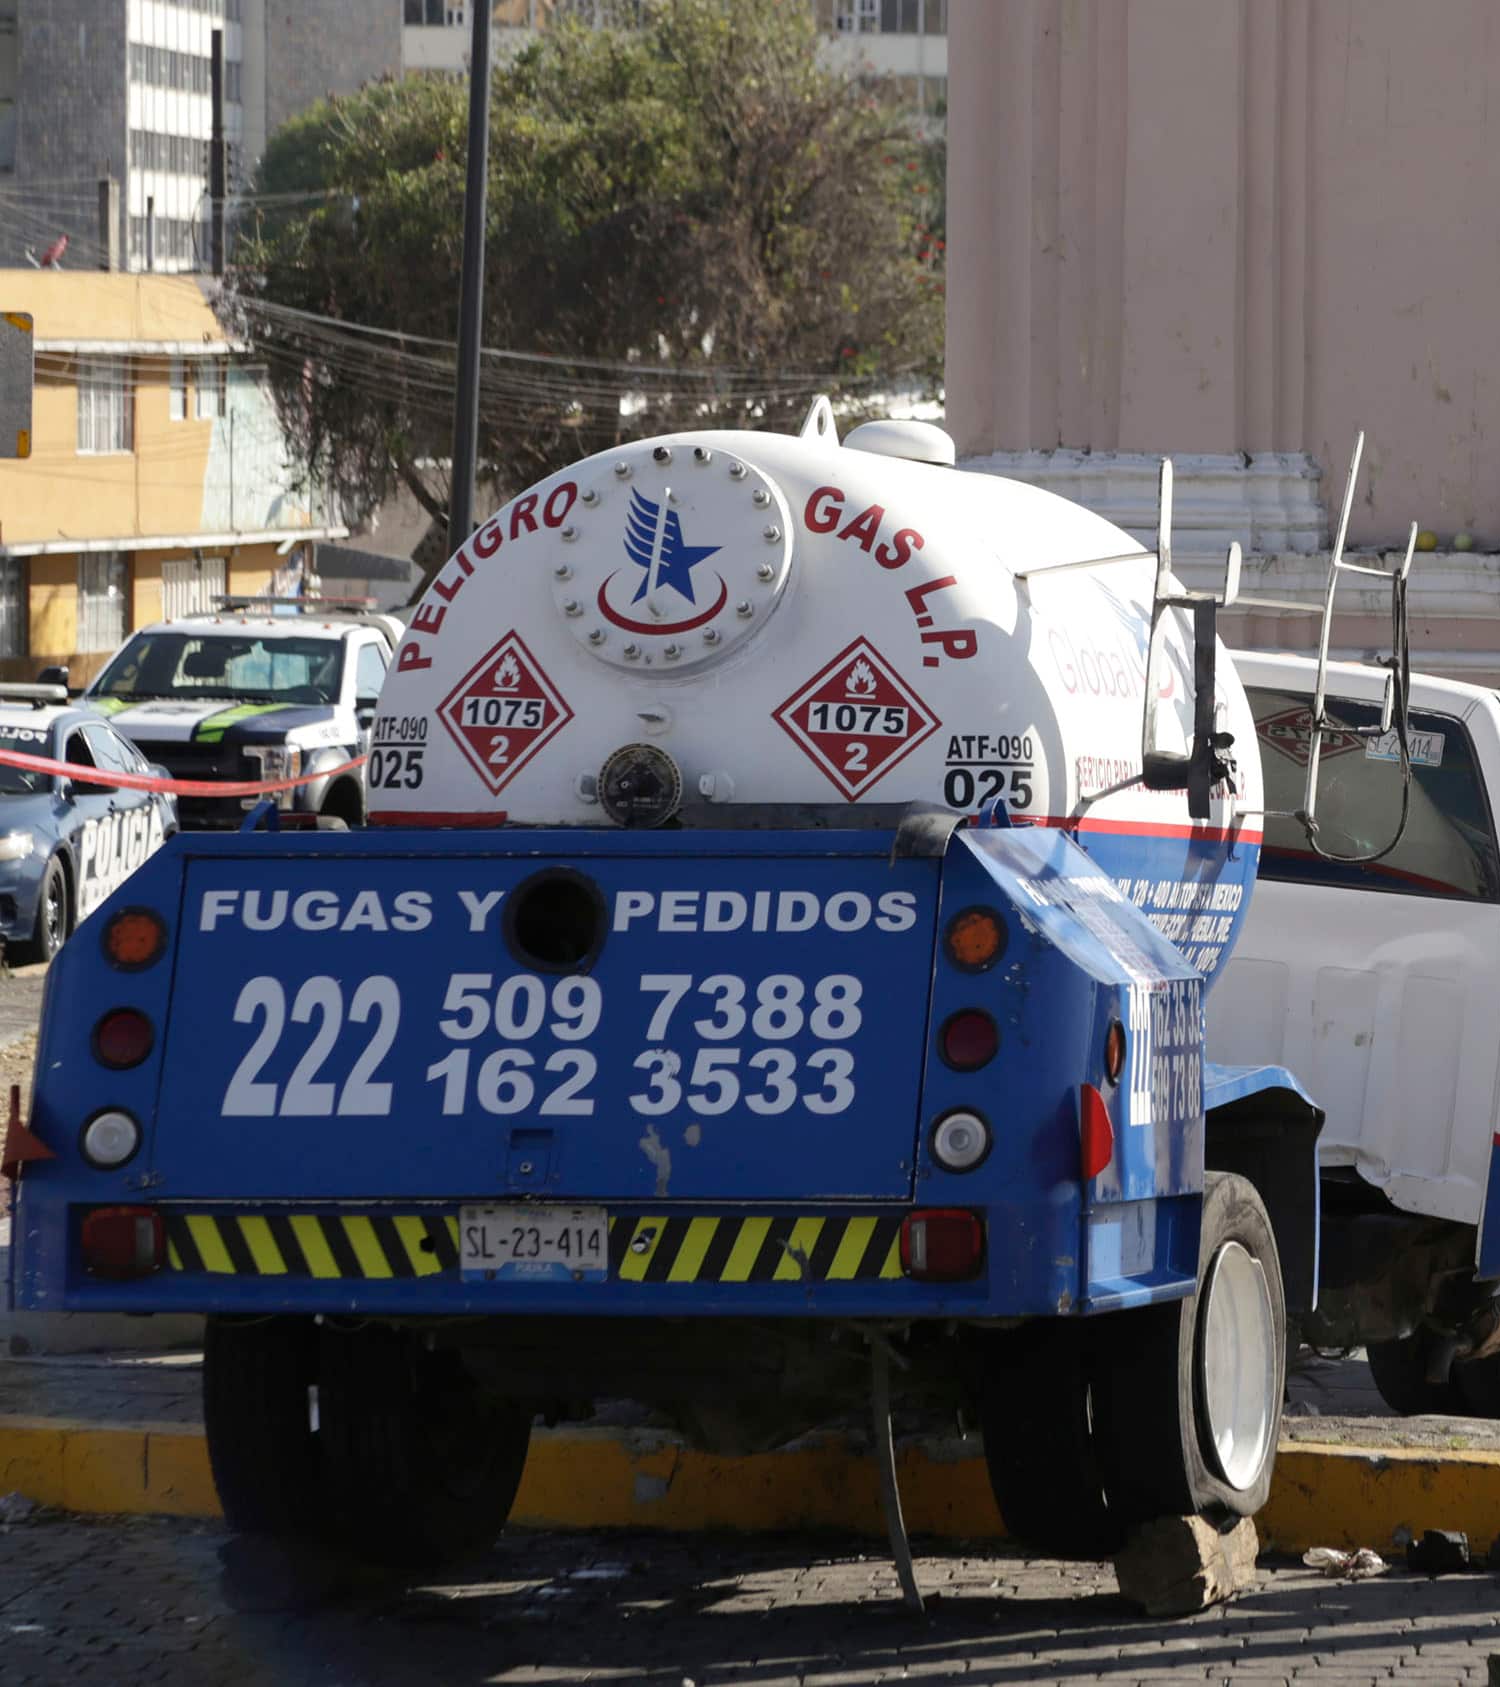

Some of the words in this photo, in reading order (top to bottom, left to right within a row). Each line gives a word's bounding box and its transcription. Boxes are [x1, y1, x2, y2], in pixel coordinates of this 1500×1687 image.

[802, 485, 925, 570] GAS
[397, 480, 579, 673] PELIGRO
[374, 716, 428, 741] ATF-090
[465, 698, 543, 729] 1075
[811, 702, 905, 736] 1075
[487, 735, 510, 765] 2
[844, 742, 868, 772] 2
[946, 734, 1034, 760] ATF-090
[368, 749, 424, 790] 025
[943, 768, 1033, 809] 025
[81, 799, 167, 880] POLICIA
[200, 890, 433, 932] FUGAS
[456, 890, 505, 932] Y
[611, 889, 918, 932] PEDIDOS
[1209, 884, 1243, 912] MEXICO
[220, 974, 402, 1117] 222
[438, 973, 603, 1041] 509
[638, 973, 864, 1041] 7388
[1129, 982, 1151, 1127] 222
[1173, 981, 1186, 1046] 35
[425, 1048, 597, 1116] 162
[628, 1047, 856, 1116] 3533
[1151, 1055, 1170, 1122] 509
[1173, 1054, 1186, 1121] 73
[1188, 1052, 1200, 1120] 88
[466, 1225, 601, 1259] SL-23-414
